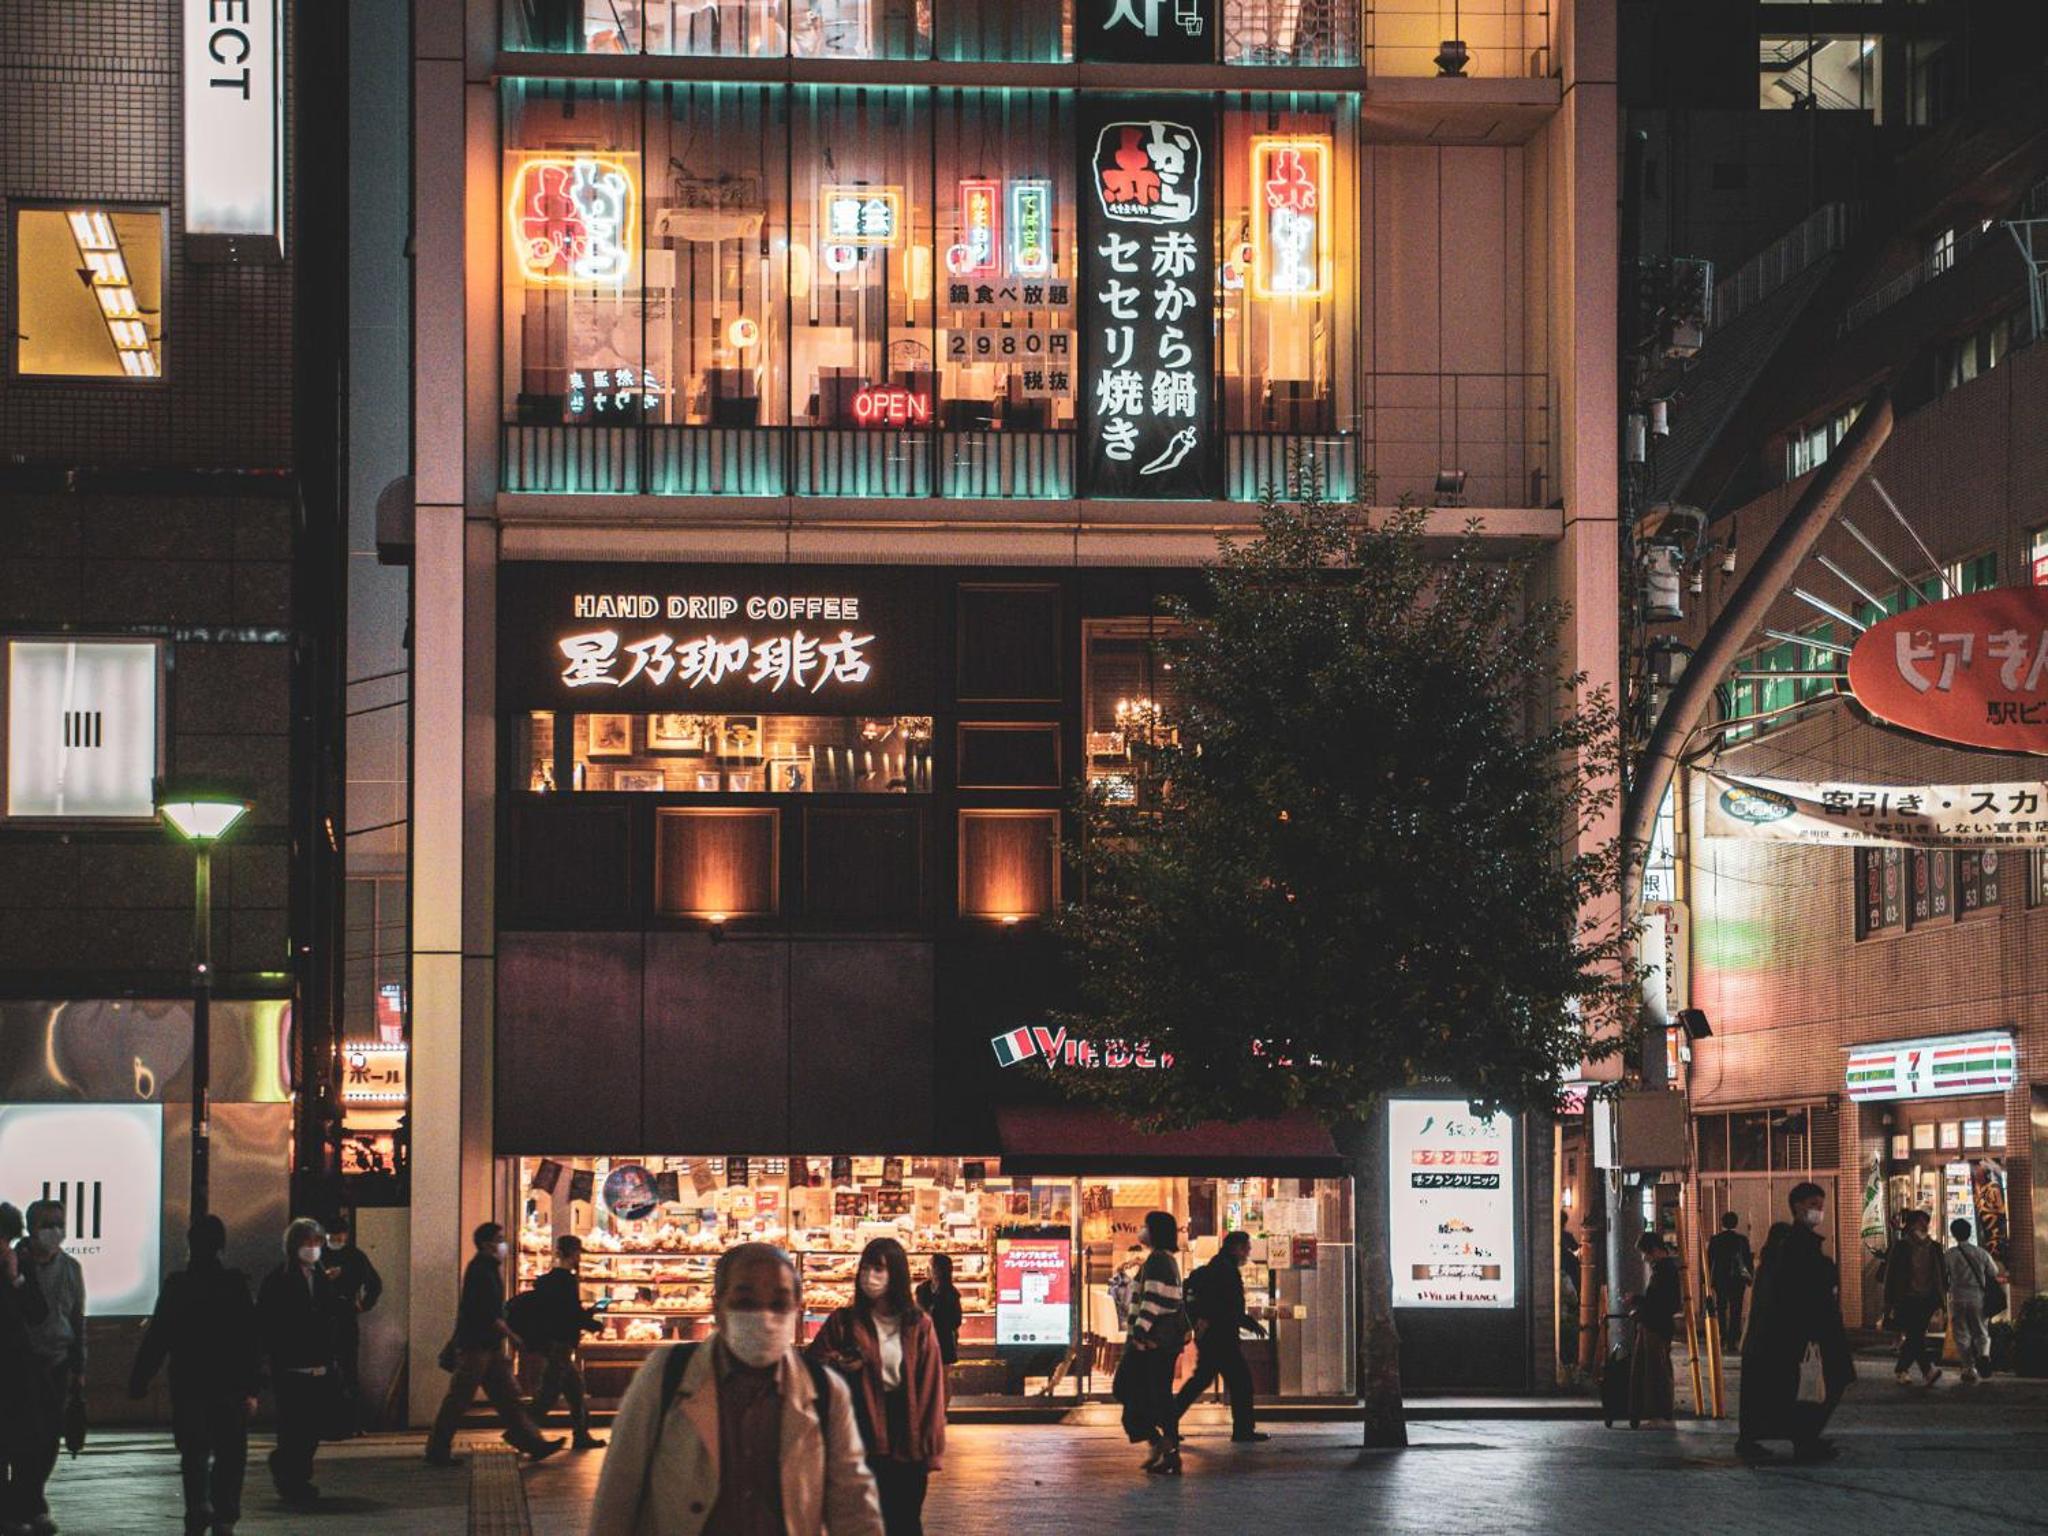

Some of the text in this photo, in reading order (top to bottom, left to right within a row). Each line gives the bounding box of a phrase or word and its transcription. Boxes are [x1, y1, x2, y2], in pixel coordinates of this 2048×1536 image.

[950, 285, 1069, 305] 鍋食べ放題
[1151, 231, 1198, 418] 赤から鍋
[951, 334, 1068, 354] 2980円
[1096, 232, 1144, 461] セセリ焼き
[1023, 370, 1069, 391] 税抜
[854, 393, 927, 418] OPEN
[574, 595, 859, 620] HAND DRIP COFFEE
[558, 630, 876, 694] 星乃珈琲店
[1986, 701, 2048, 725] 駅ビ
